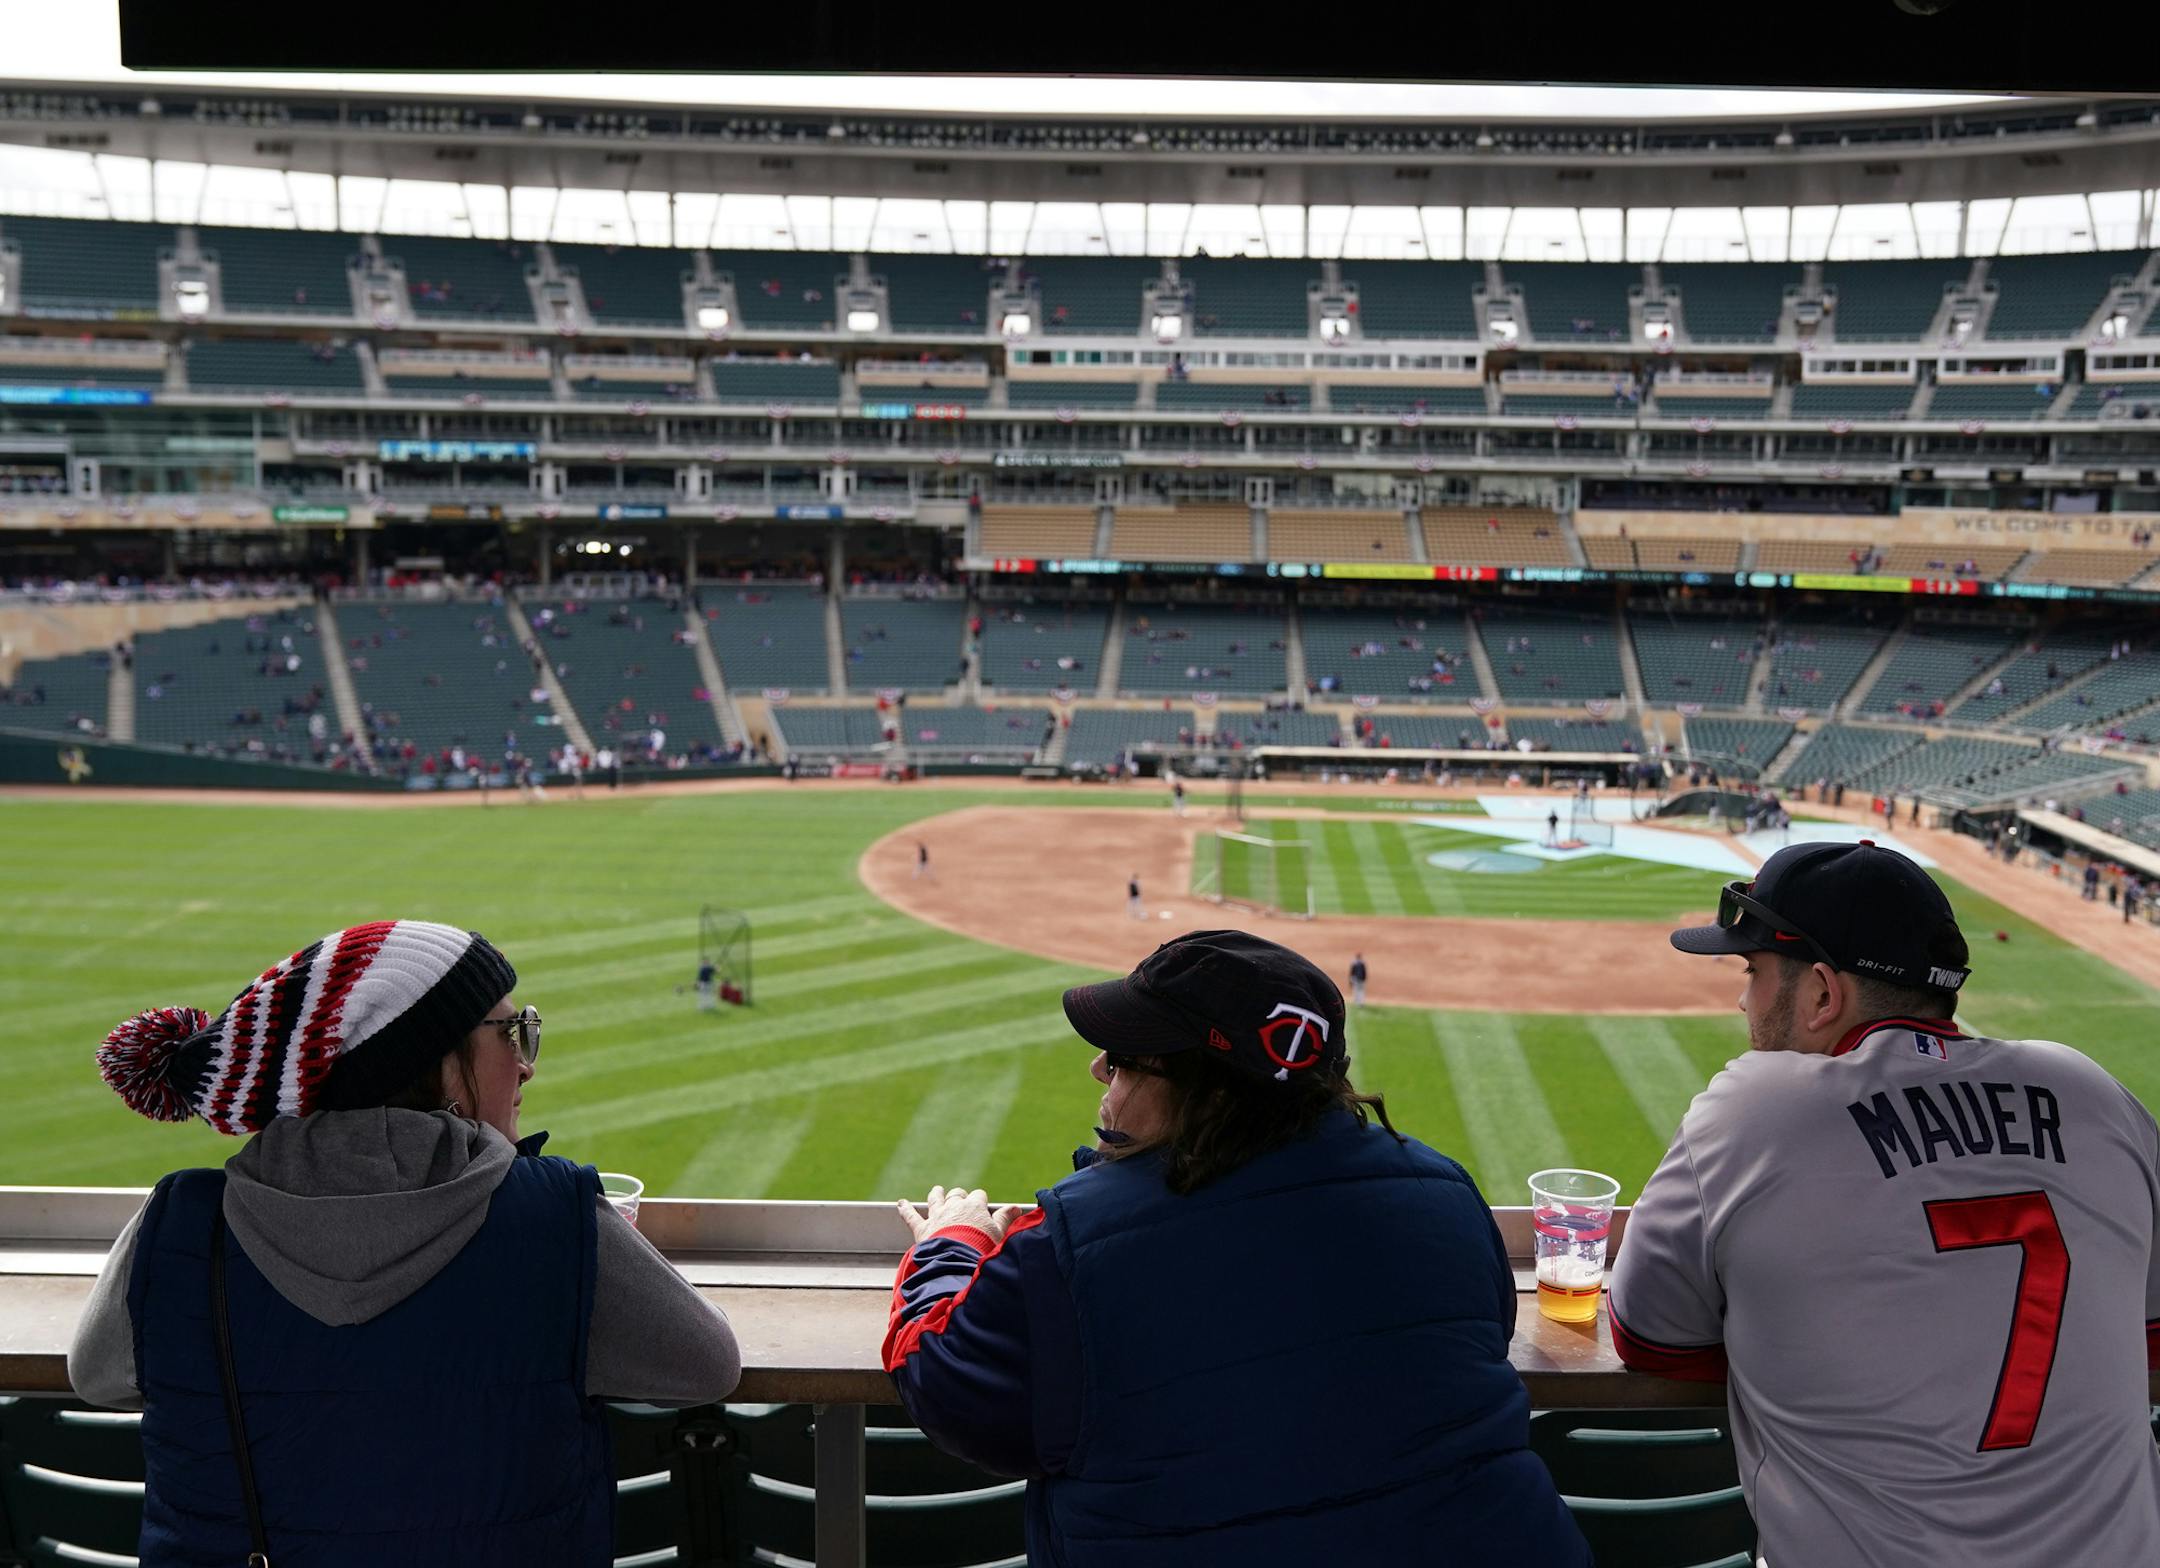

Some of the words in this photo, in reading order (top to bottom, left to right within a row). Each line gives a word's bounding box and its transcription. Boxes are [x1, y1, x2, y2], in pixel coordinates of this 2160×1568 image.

[1952, 515, 2073, 534] WELCOME
[2080, 518, 2112, 536] TO
[1856, 958, 1905, 976] DRI-FIT
[1927, 966, 1965, 989] TWINS
[1846, 1080, 2067, 1180] MAUER
[1922, 1189, 2071, 1454] 7
